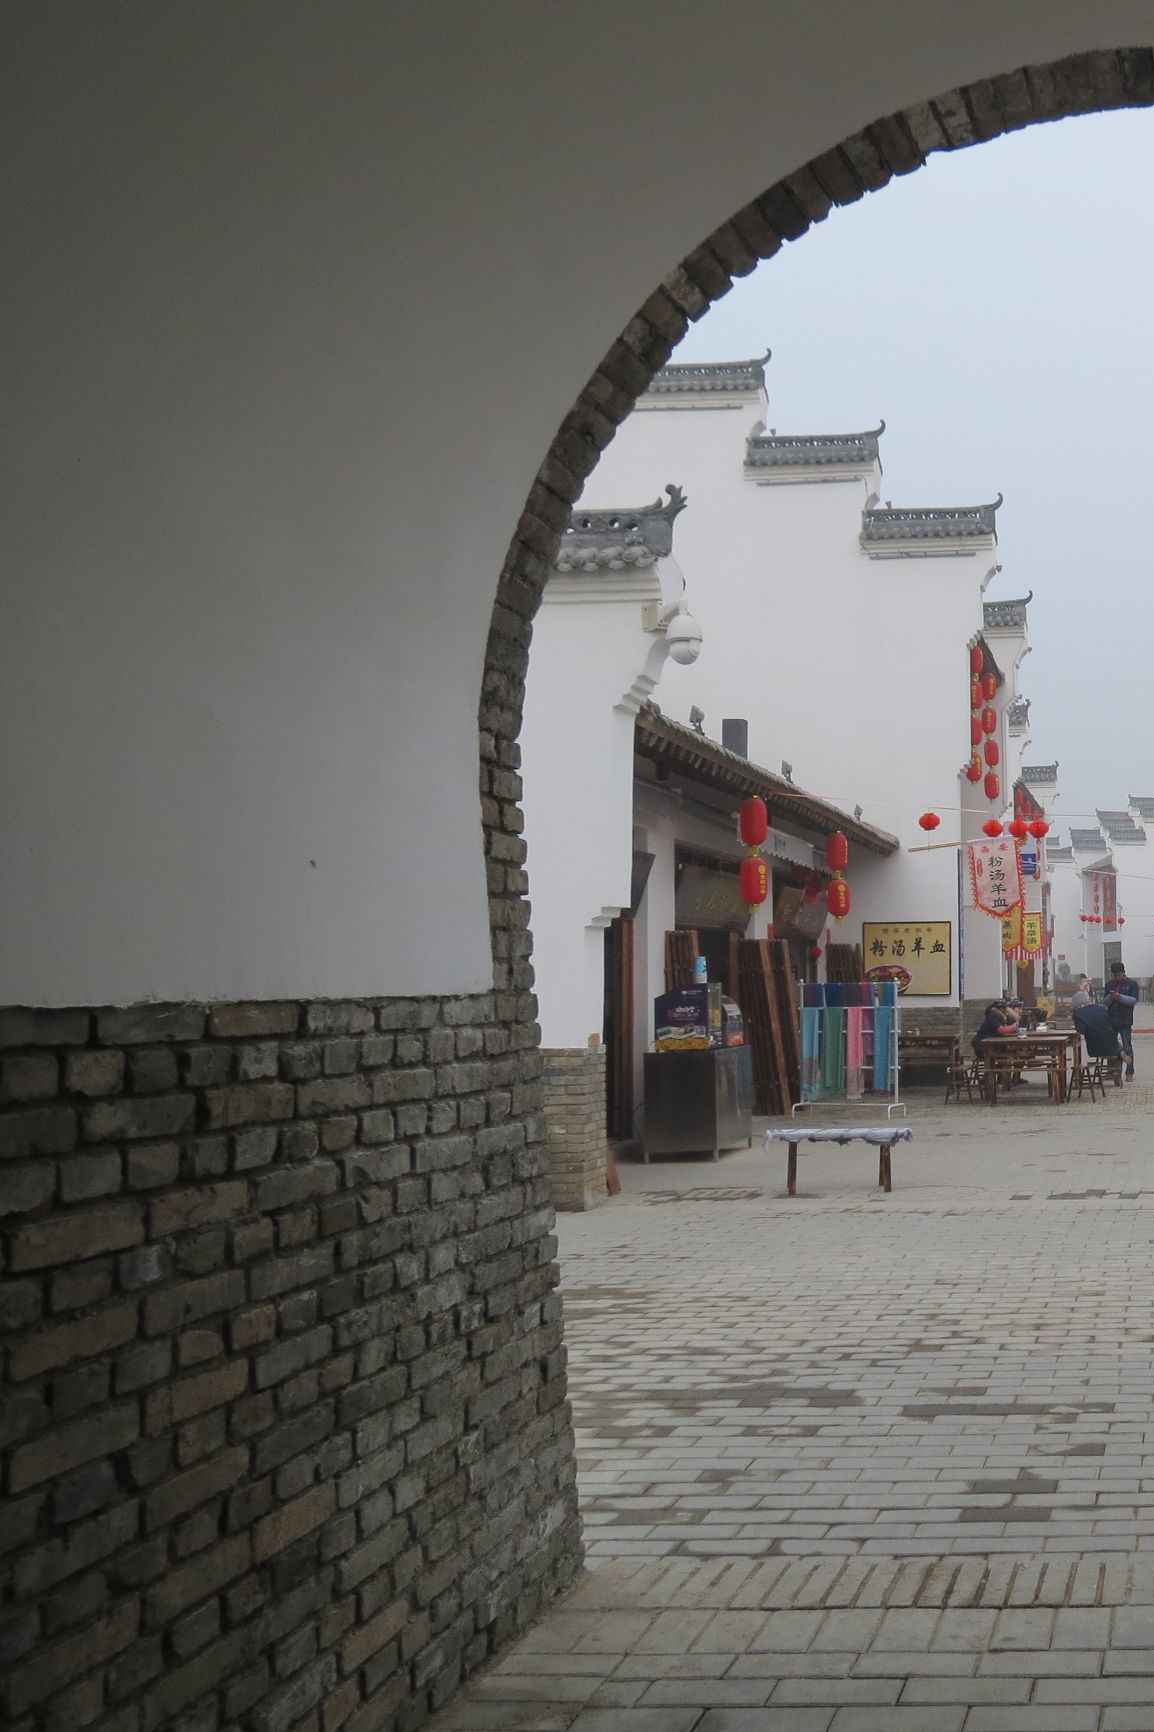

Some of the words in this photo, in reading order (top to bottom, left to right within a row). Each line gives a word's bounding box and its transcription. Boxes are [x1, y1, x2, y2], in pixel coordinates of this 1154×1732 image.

[988, 856, 1009, 909] 粉汤羊血
[870, 937, 946, 958] 粉汤羊血
